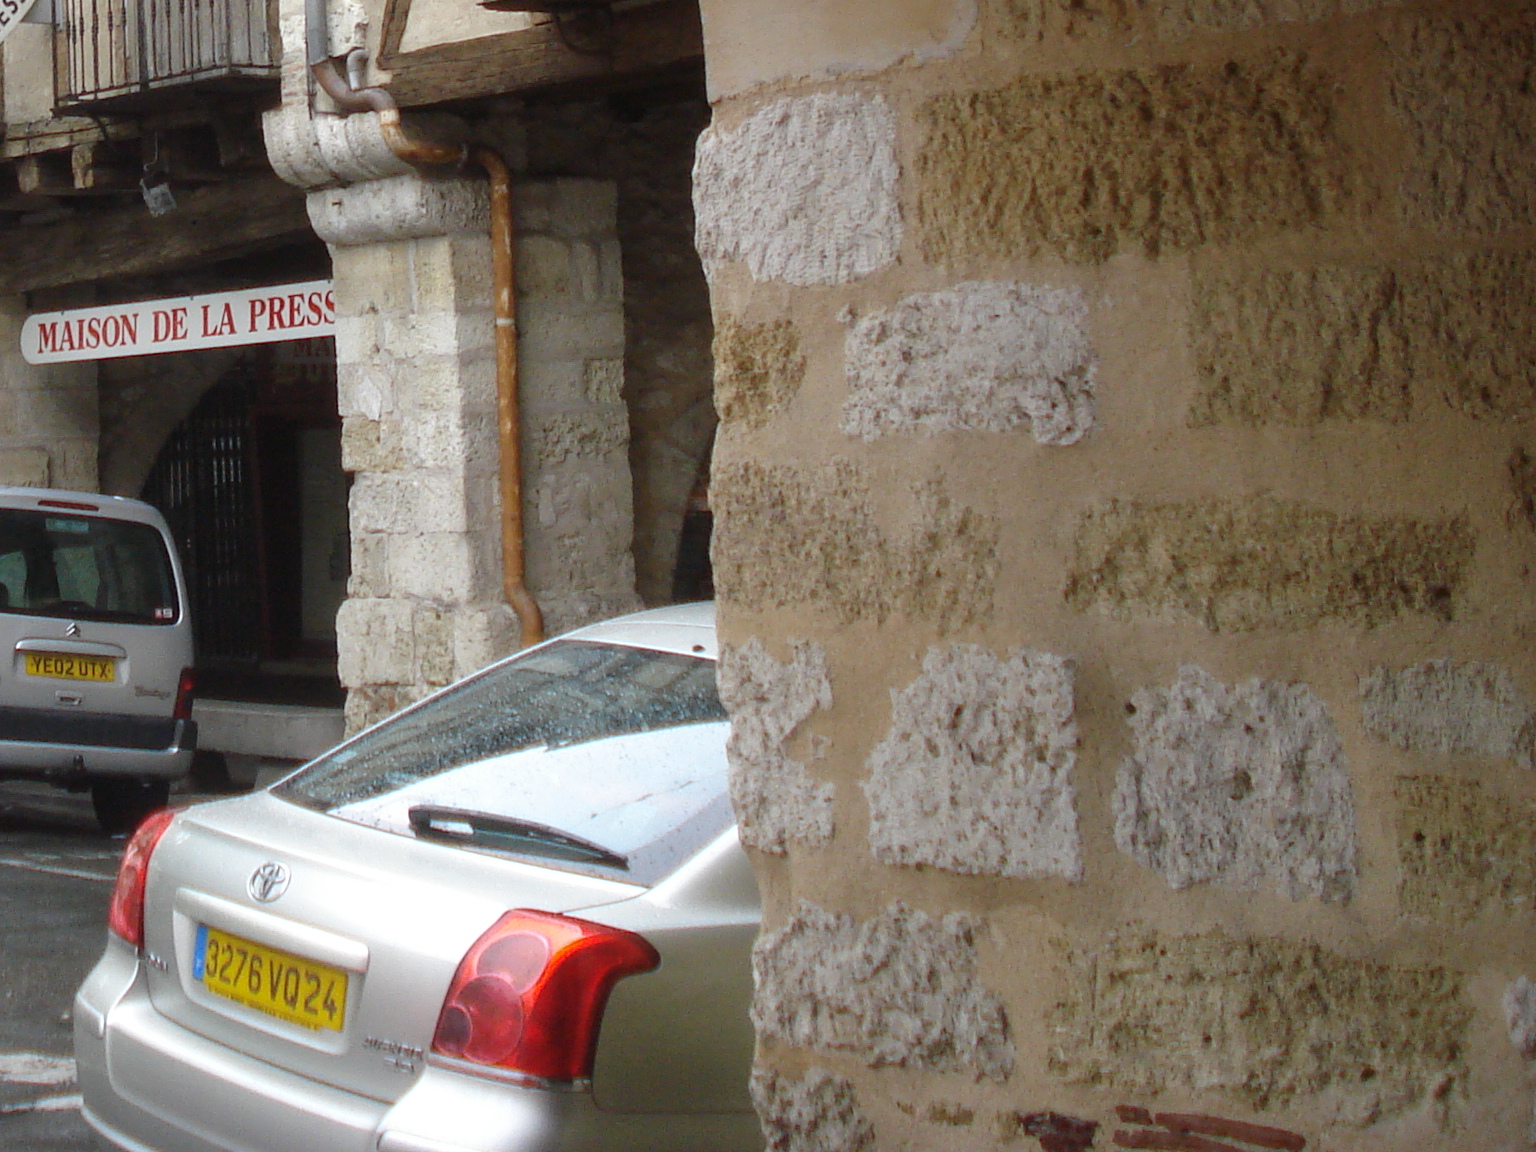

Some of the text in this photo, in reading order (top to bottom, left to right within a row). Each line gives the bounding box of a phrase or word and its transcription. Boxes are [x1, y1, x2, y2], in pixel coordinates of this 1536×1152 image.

[37, 312, 140, 355] MAISON
[151, 307, 189, 344] DE
[200, 302, 238, 338] LA
[33, 657, 109, 679] YE02 UTX
[205, 938, 262, 995] 3276
[269, 963, 300, 1011] VQ
[303, 971, 338, 1022] 24
